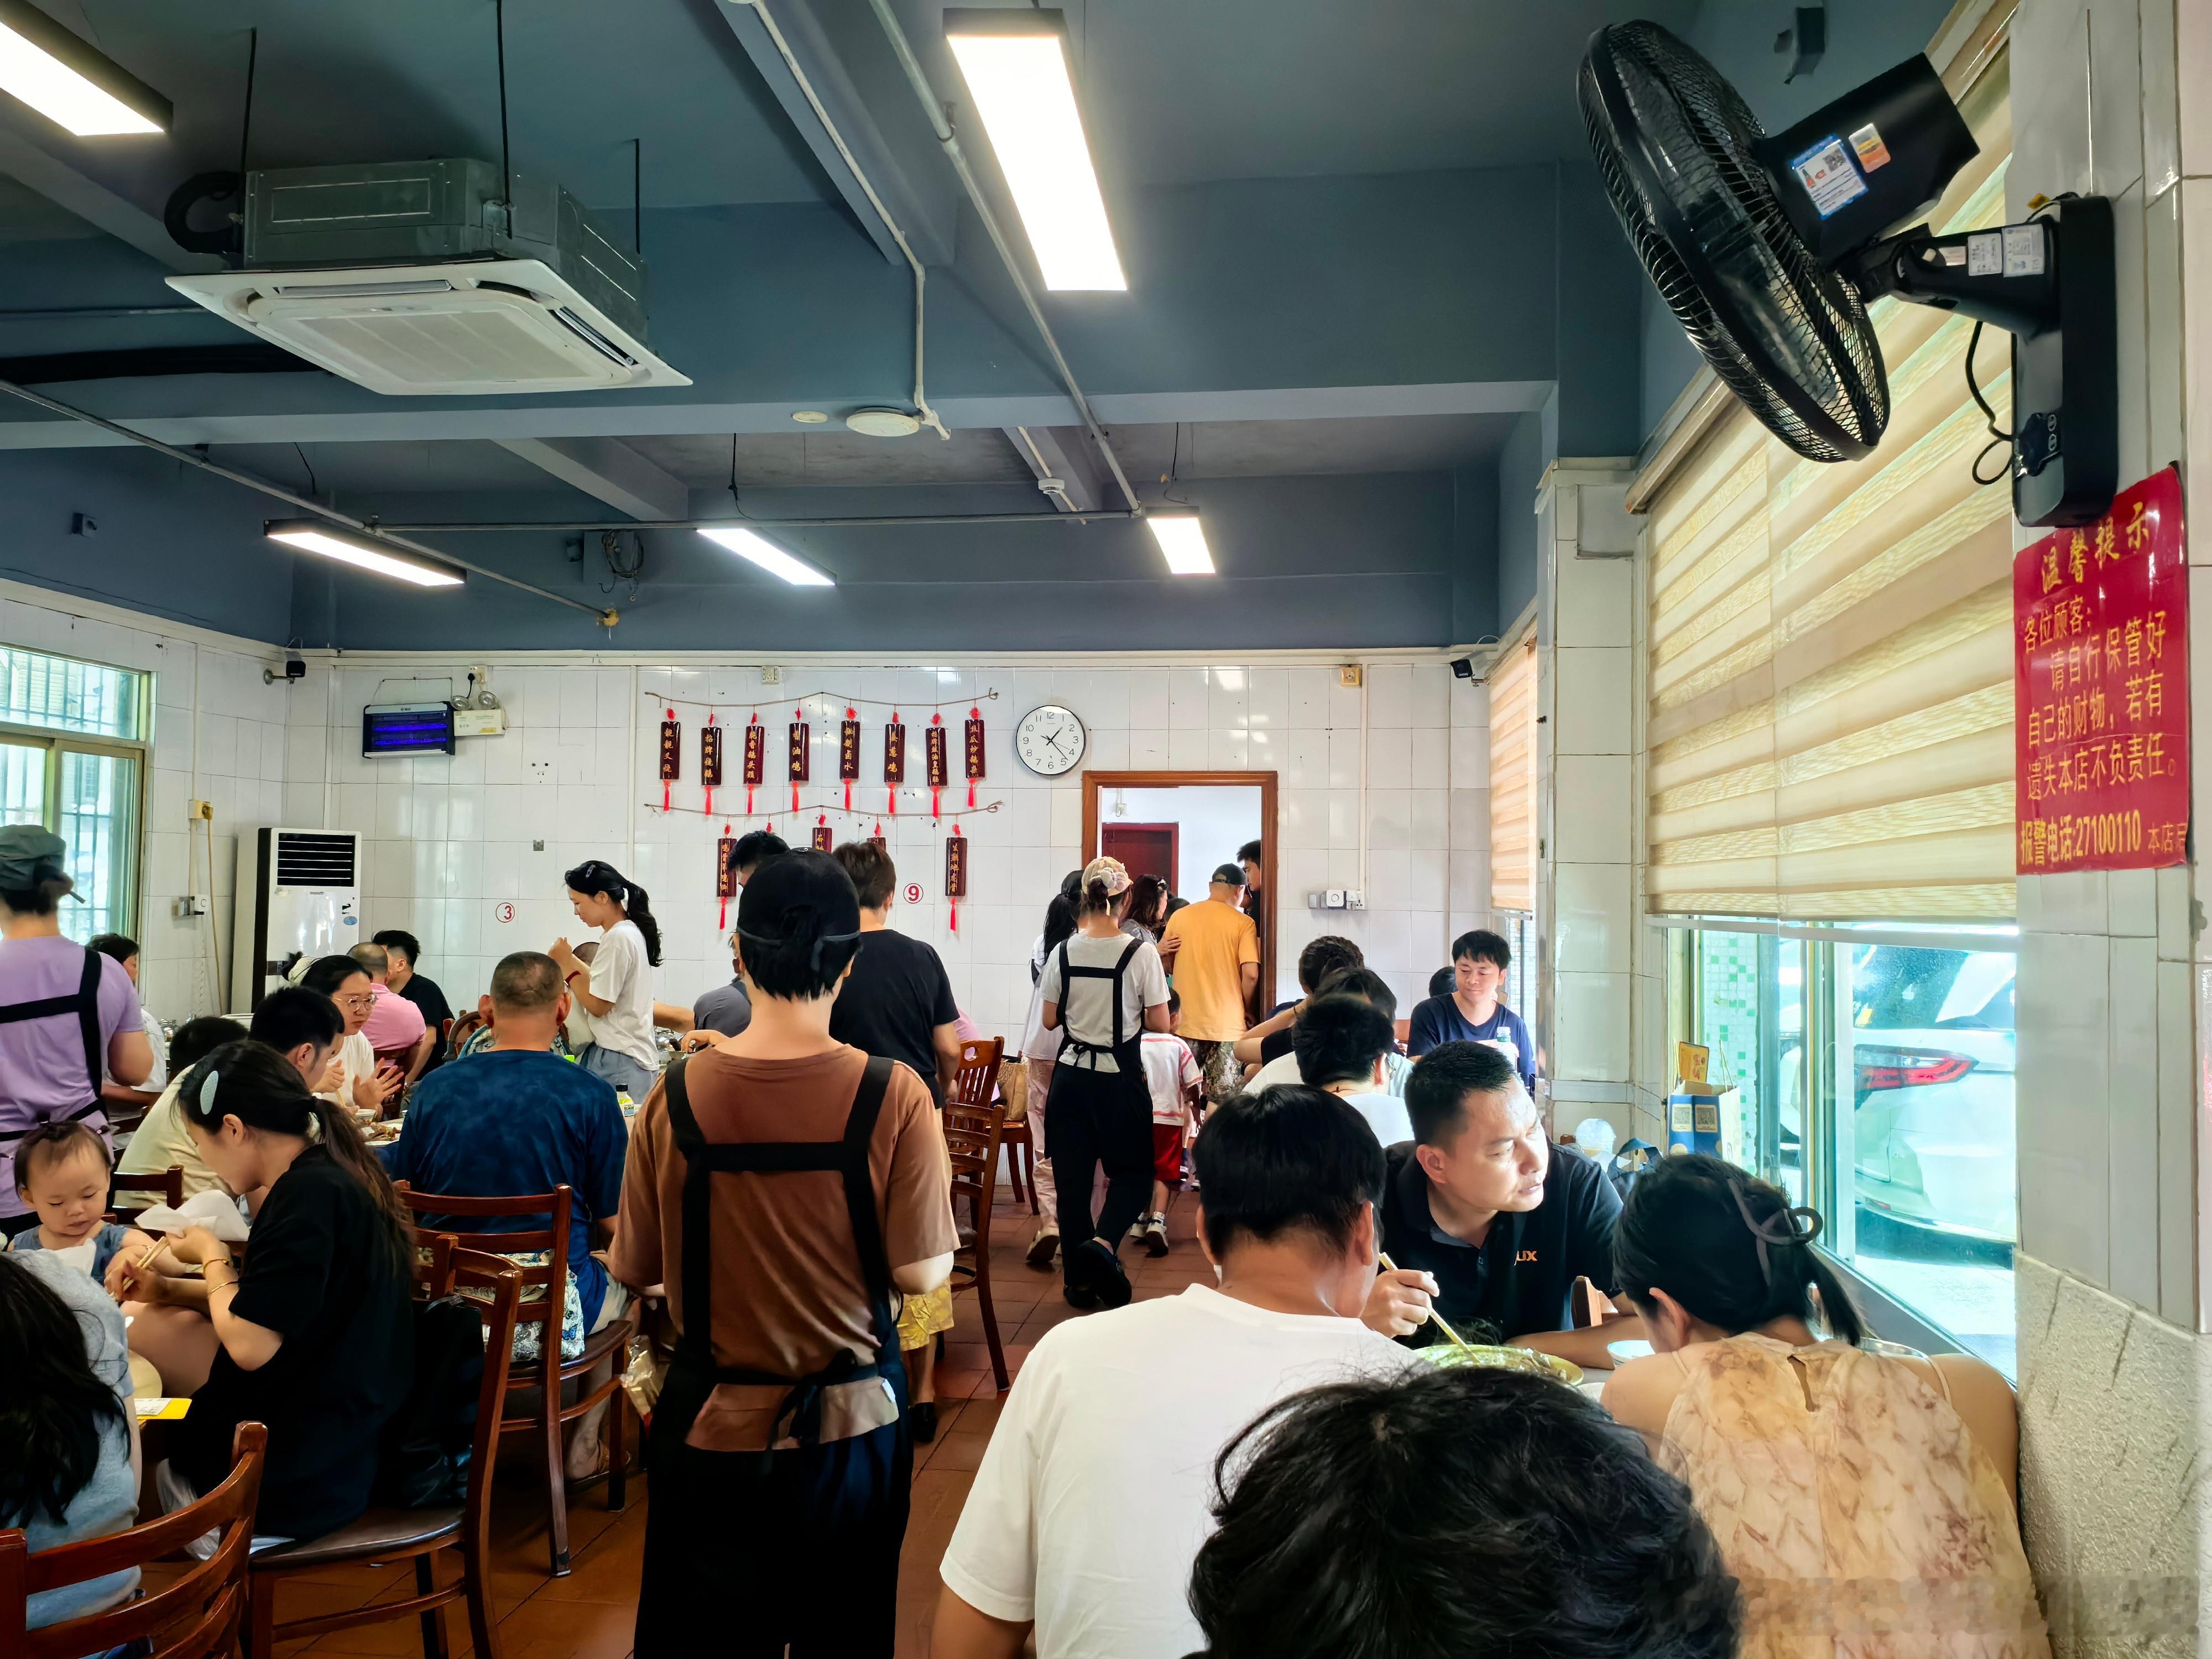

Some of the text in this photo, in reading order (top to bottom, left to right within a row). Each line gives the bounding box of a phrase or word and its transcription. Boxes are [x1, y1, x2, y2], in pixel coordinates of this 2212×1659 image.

[2041, 501, 2149, 594] 温馨提示
[2050, 610, 2166, 691] 请自行保管好
[504, 905, 512, 920] 3
[908, 885, 919, 901] 9
